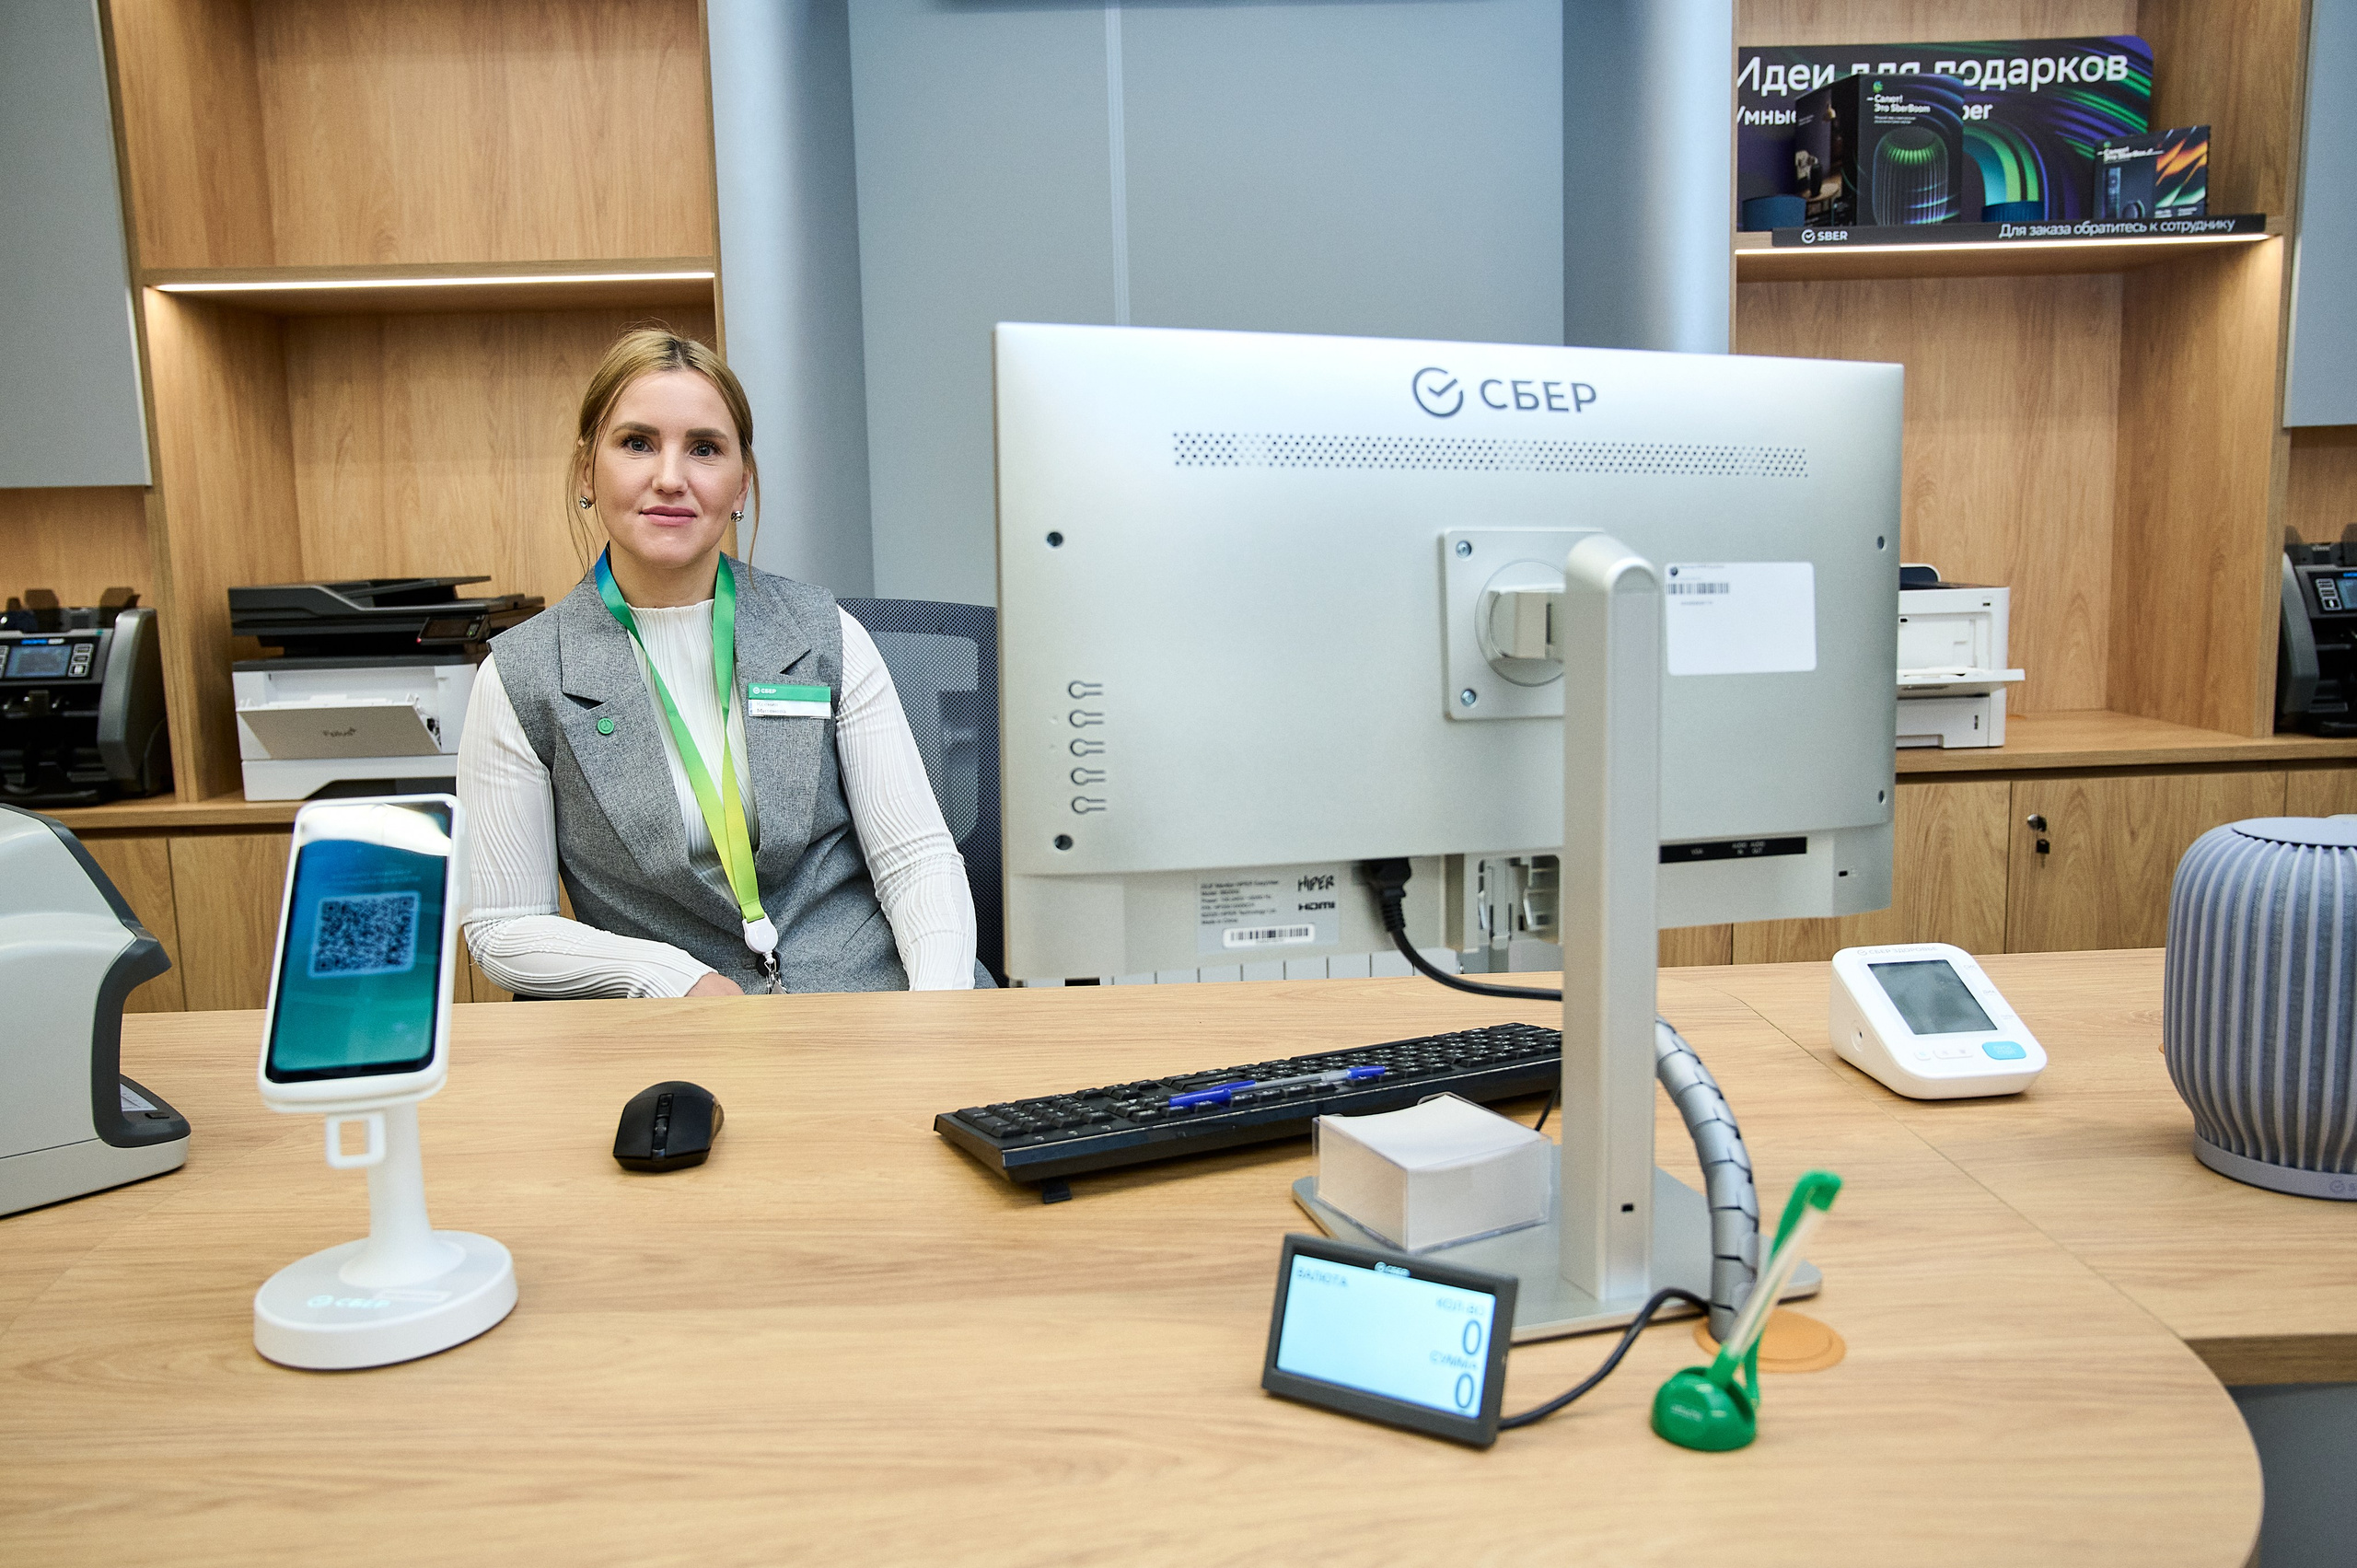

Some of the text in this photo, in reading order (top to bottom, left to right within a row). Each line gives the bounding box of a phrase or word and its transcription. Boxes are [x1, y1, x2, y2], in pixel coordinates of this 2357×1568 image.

[1817, 230, 1849, 241] SBER
[1998, 219, 2235, 238] Для заказа обратитесь к сотруднику
[1480, 378, 1596, 412] СБЕР
[1297, 875, 1335, 892] HIPER
[1298, 901, 1335, 911] HDMI
[1462, 1319, 1481, 1355] 0
[1456, 1373, 1474, 1409] 0
